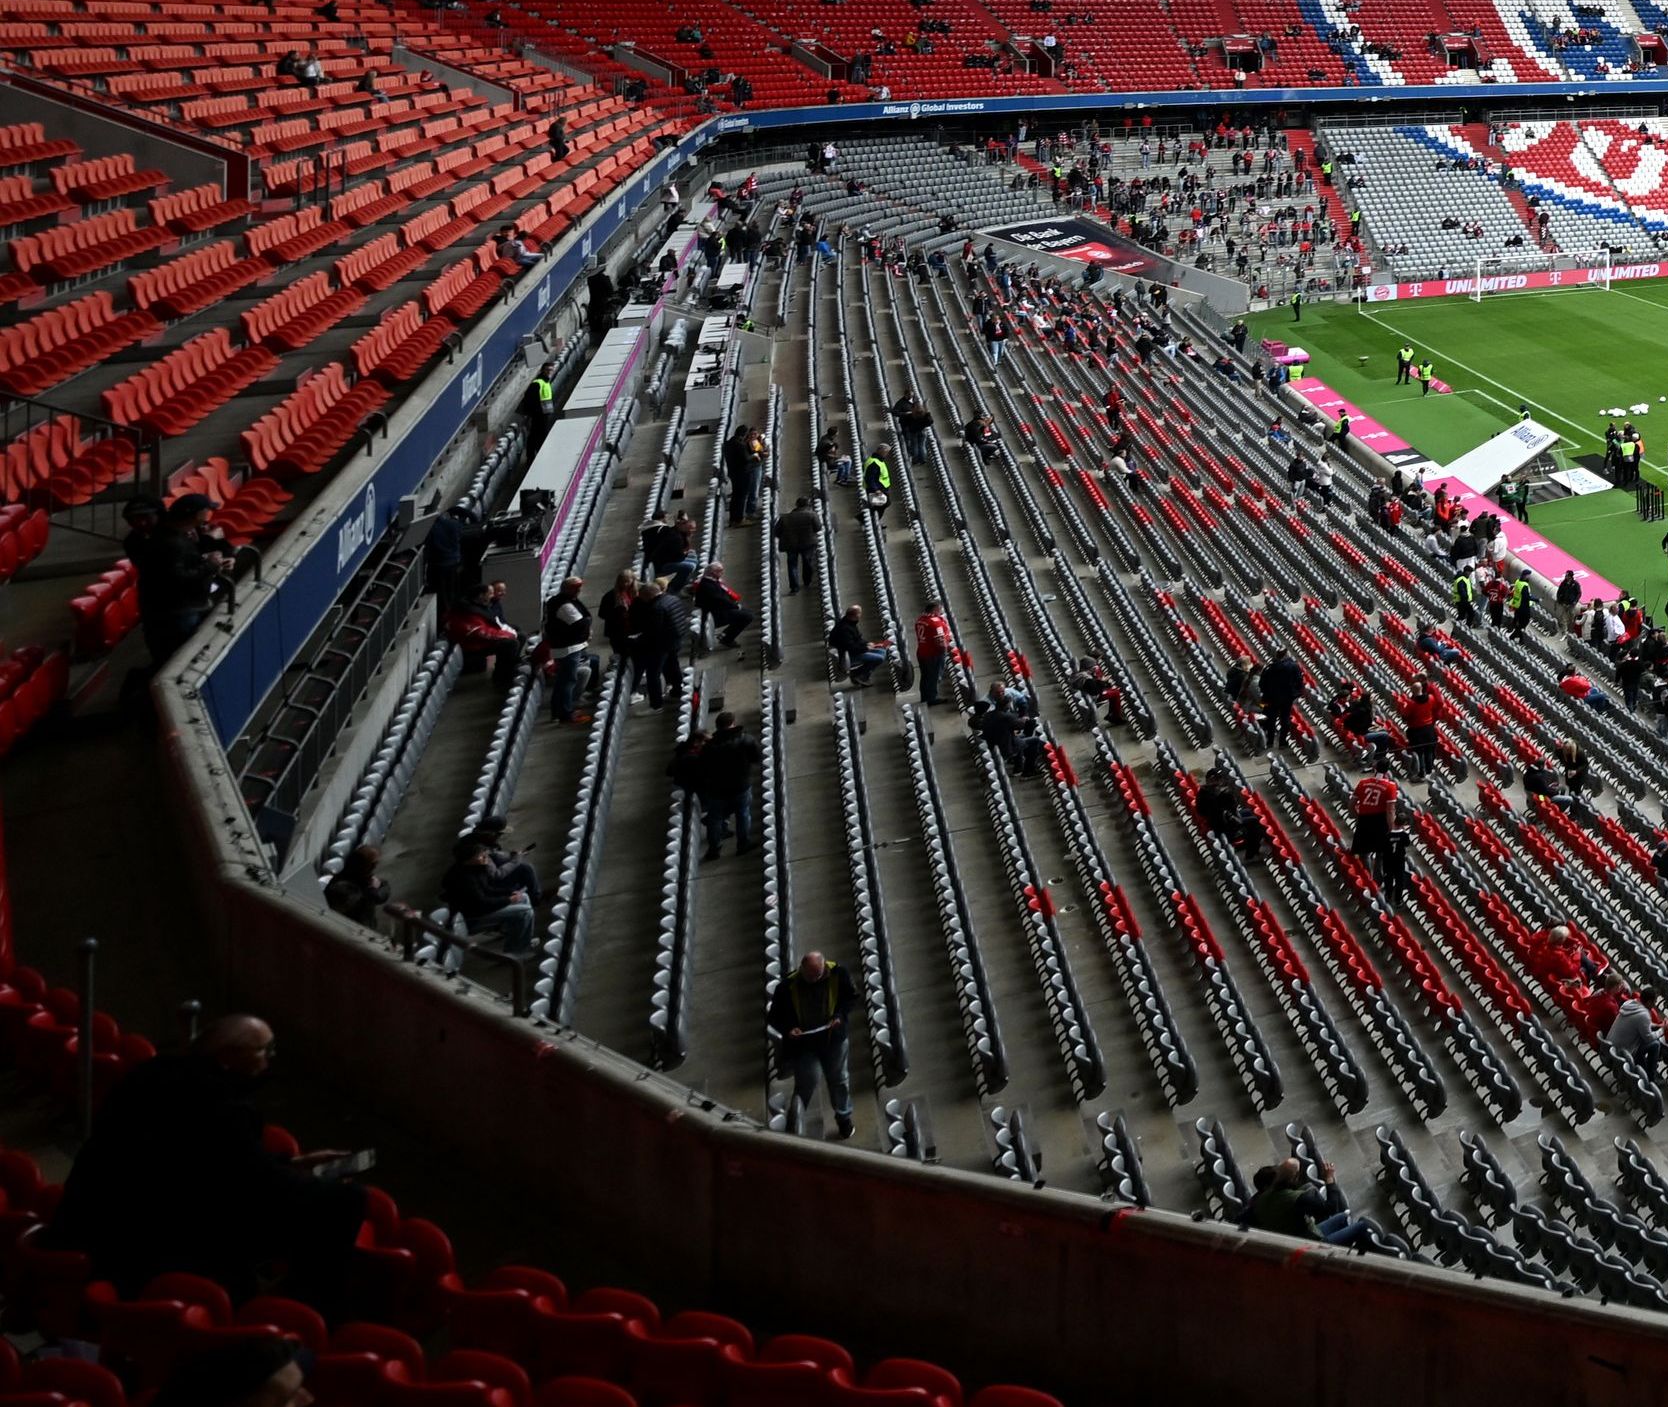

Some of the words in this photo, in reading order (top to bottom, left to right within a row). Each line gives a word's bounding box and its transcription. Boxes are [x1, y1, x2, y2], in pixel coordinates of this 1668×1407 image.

[882, 105, 909, 115] Allianz
[920, 103, 944, 113] Global
[945, 101, 985, 112] Investors
[1010, 230, 1033, 243] Die
[1031, 226, 1064, 240] Bank
[1587, 263, 1660, 282] UNLIMITED
[337, 521, 365, 574] Allianz
[1362, 787, 1380, 806] 23
